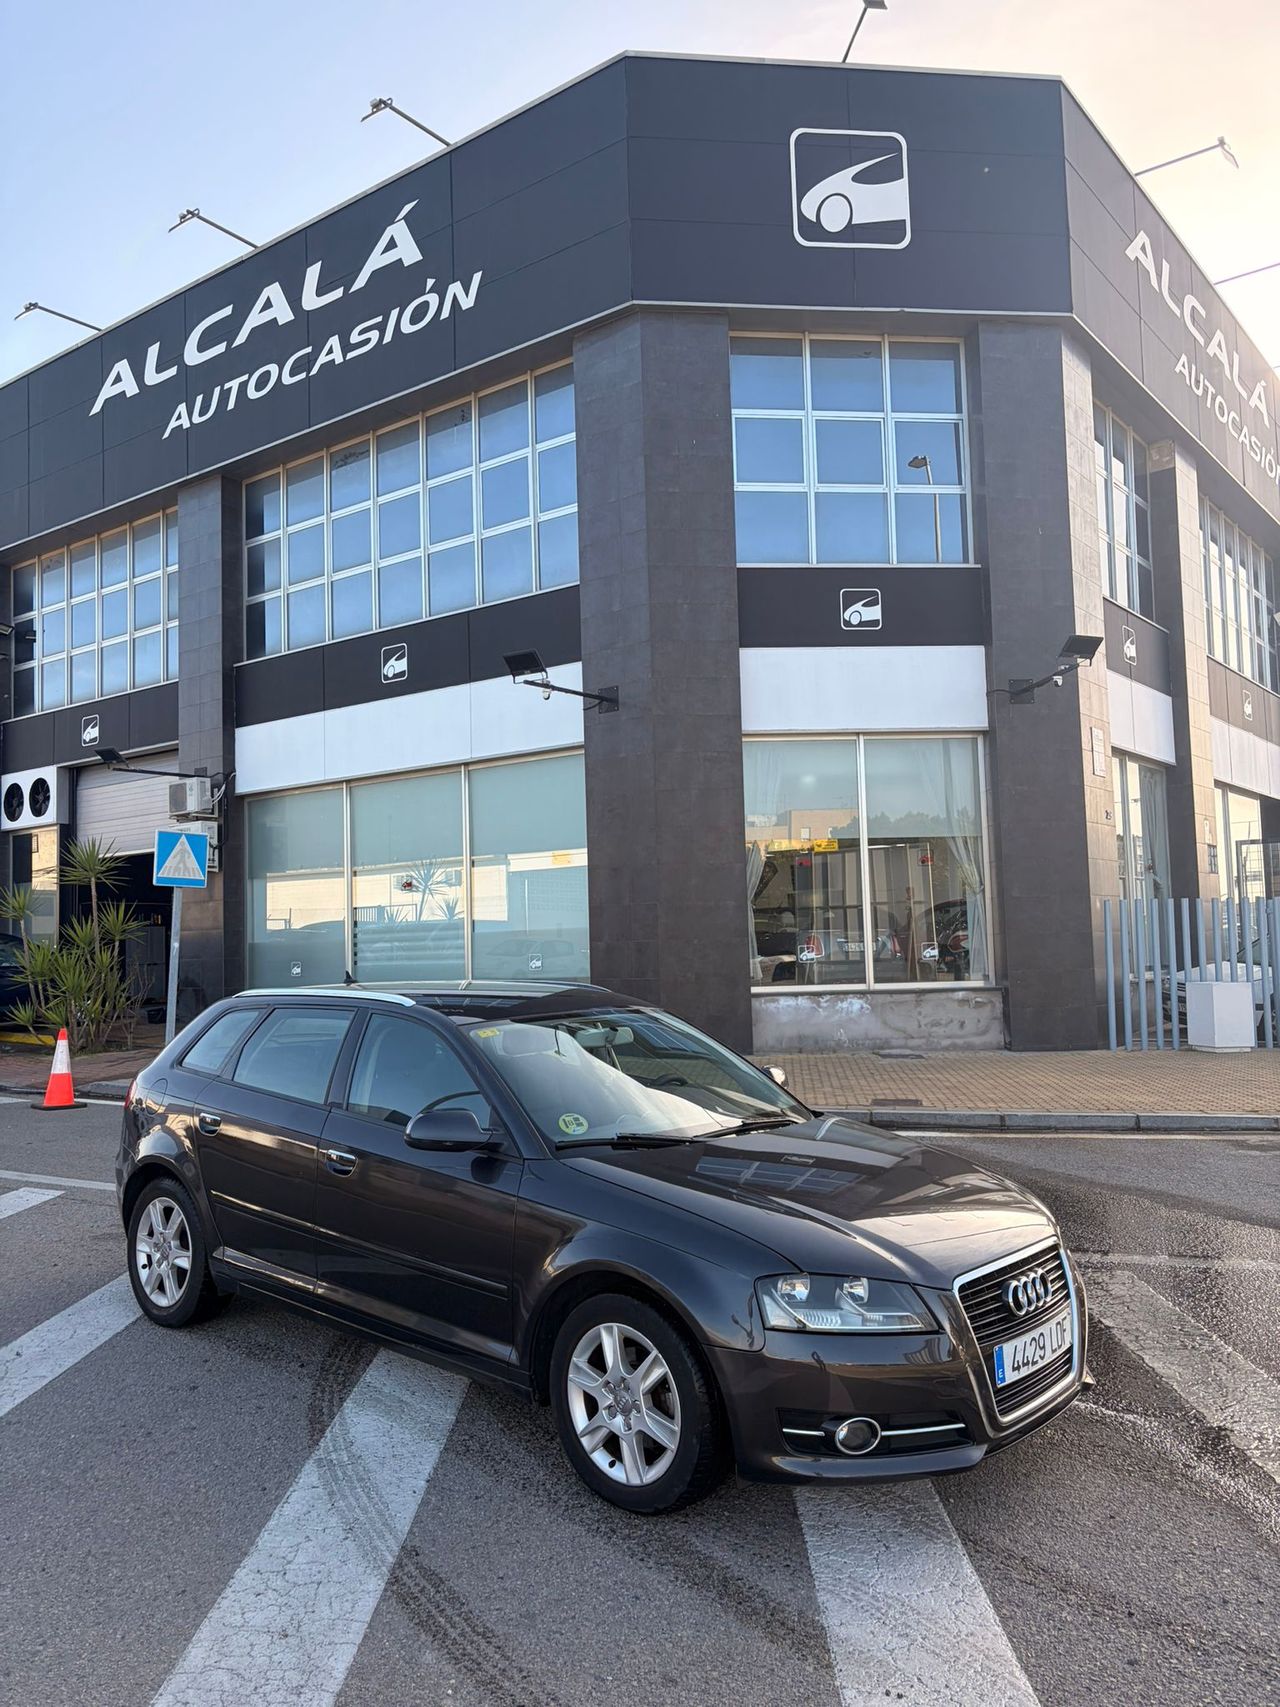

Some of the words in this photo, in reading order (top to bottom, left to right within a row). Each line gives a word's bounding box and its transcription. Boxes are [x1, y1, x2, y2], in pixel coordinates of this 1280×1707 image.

[90, 199, 424, 416] ALCALÁ
[162, 271, 483, 440] AUTOCASIÓN
[1125, 230, 1270, 429] ALCALÁ
[998, 1368, 1004, 1378] E
[1012, 1332, 1046, 1373] 4429
[1049, 1316, 1067, 1354] LDF
